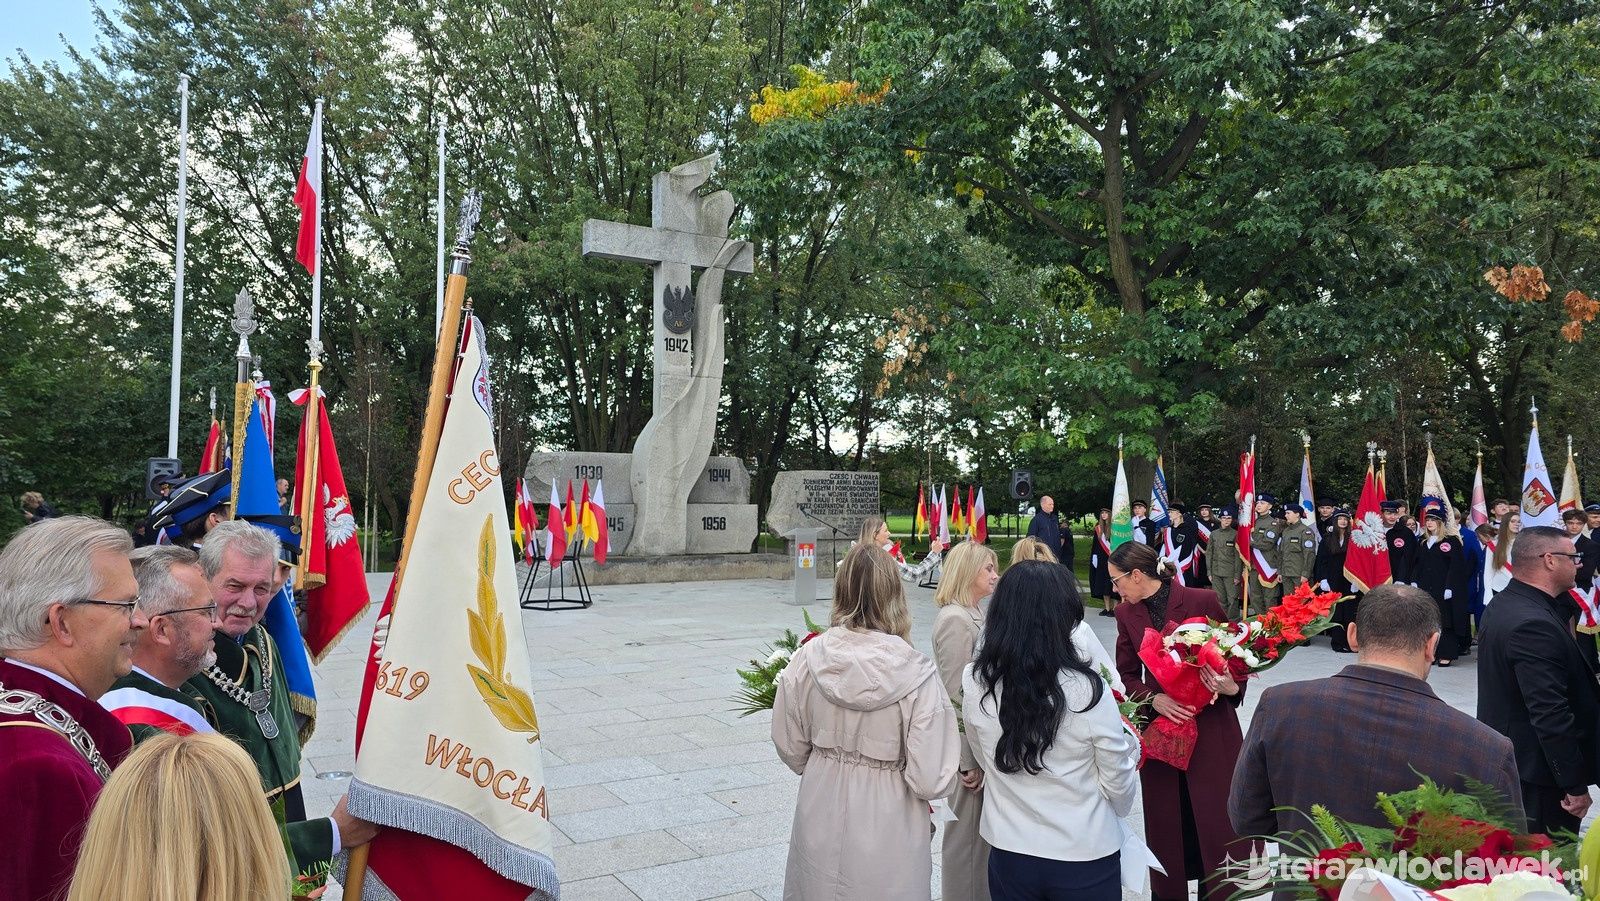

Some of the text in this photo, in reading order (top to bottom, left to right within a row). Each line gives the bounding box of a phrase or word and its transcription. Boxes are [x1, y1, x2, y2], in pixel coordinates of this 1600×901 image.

[664, 338, 688, 353] 1942
[575, 465, 603, 480] 1939
[708, 469, 731, 482] 1944
[605, 517, 624, 532] 45
[702, 516, 726, 531] 1956
